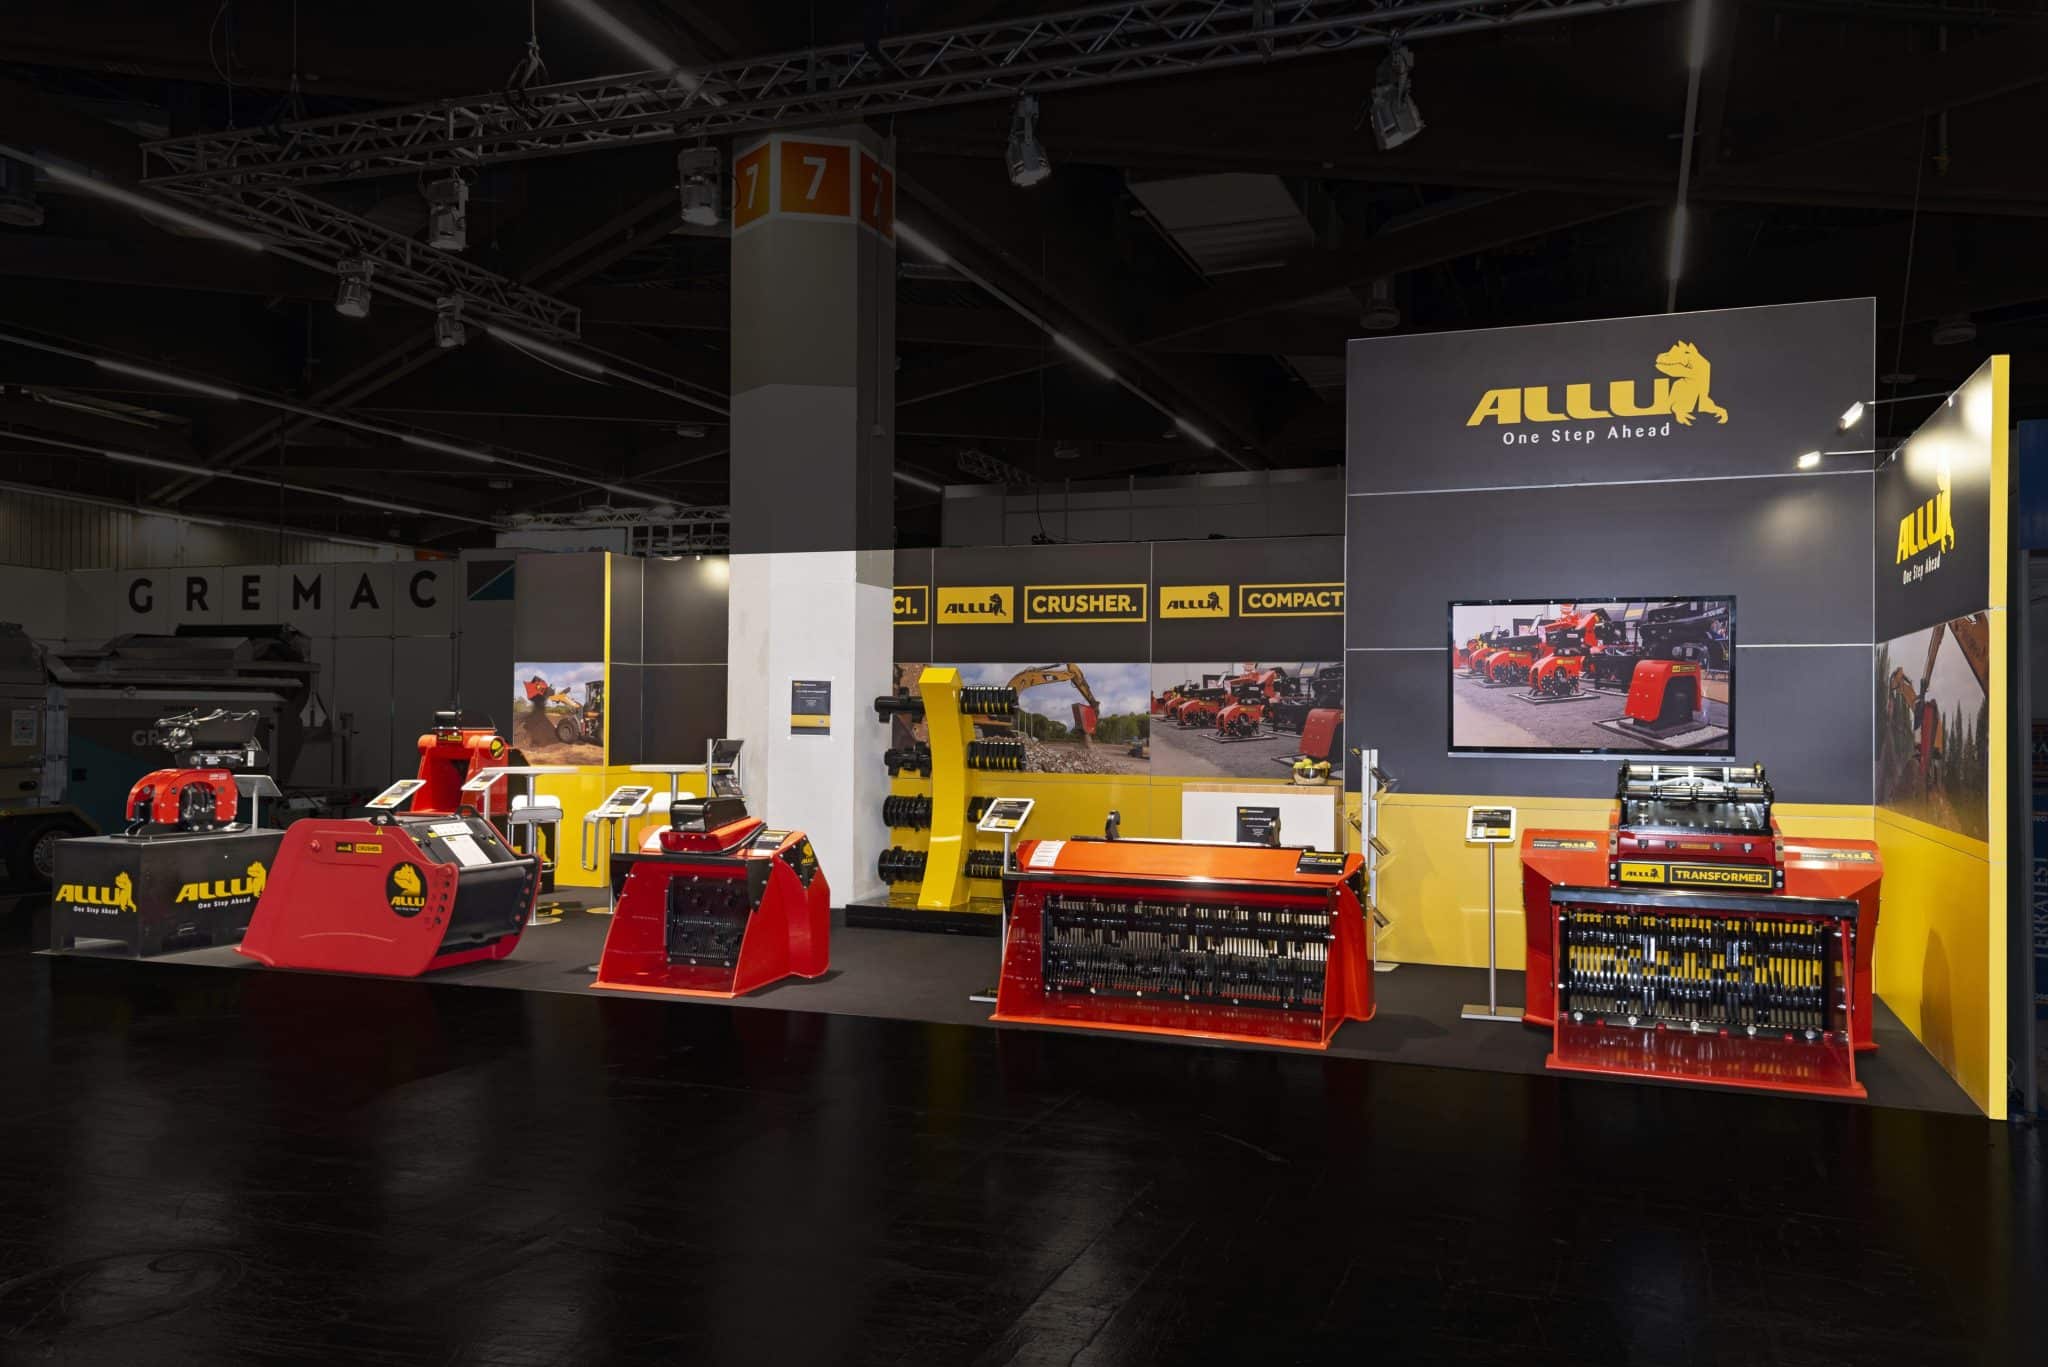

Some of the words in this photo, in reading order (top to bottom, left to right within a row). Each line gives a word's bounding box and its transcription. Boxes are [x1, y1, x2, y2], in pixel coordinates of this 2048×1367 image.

[746, 163, 759, 209] 7
[803, 156, 827, 200] 7
[1466, 377, 1673, 426] ALLU
[1503, 431, 1541, 445] One
[1551, 427, 1596, 444] Step
[1607, 422, 1671, 440] Ahead
[1896, 491, 1943, 565] ALLU
[1903, 569, 1912, 585] One
[1913, 563, 1924, 582] Step
[1925, 550, 1941, 574] Ahead
[128, 570, 437, 614] GREMAC
[944, 602, 994, 615] ALLU
[1032, 594, 1137, 614] CRUSHER.
[1166, 599, 1211, 610] ALLU
[1247, 591, 1344, 609] COMPACT
[1675, 870, 1767, 883] TRANSFORMER.
[56, 884, 122, 906] ALLU
[176, 876, 253, 903] ALLU
[391, 895, 425, 907] ALLU
[198, 901, 212, 910] One
[213, 899, 229, 909] Step
[230, 896, 251, 906] Ahead
